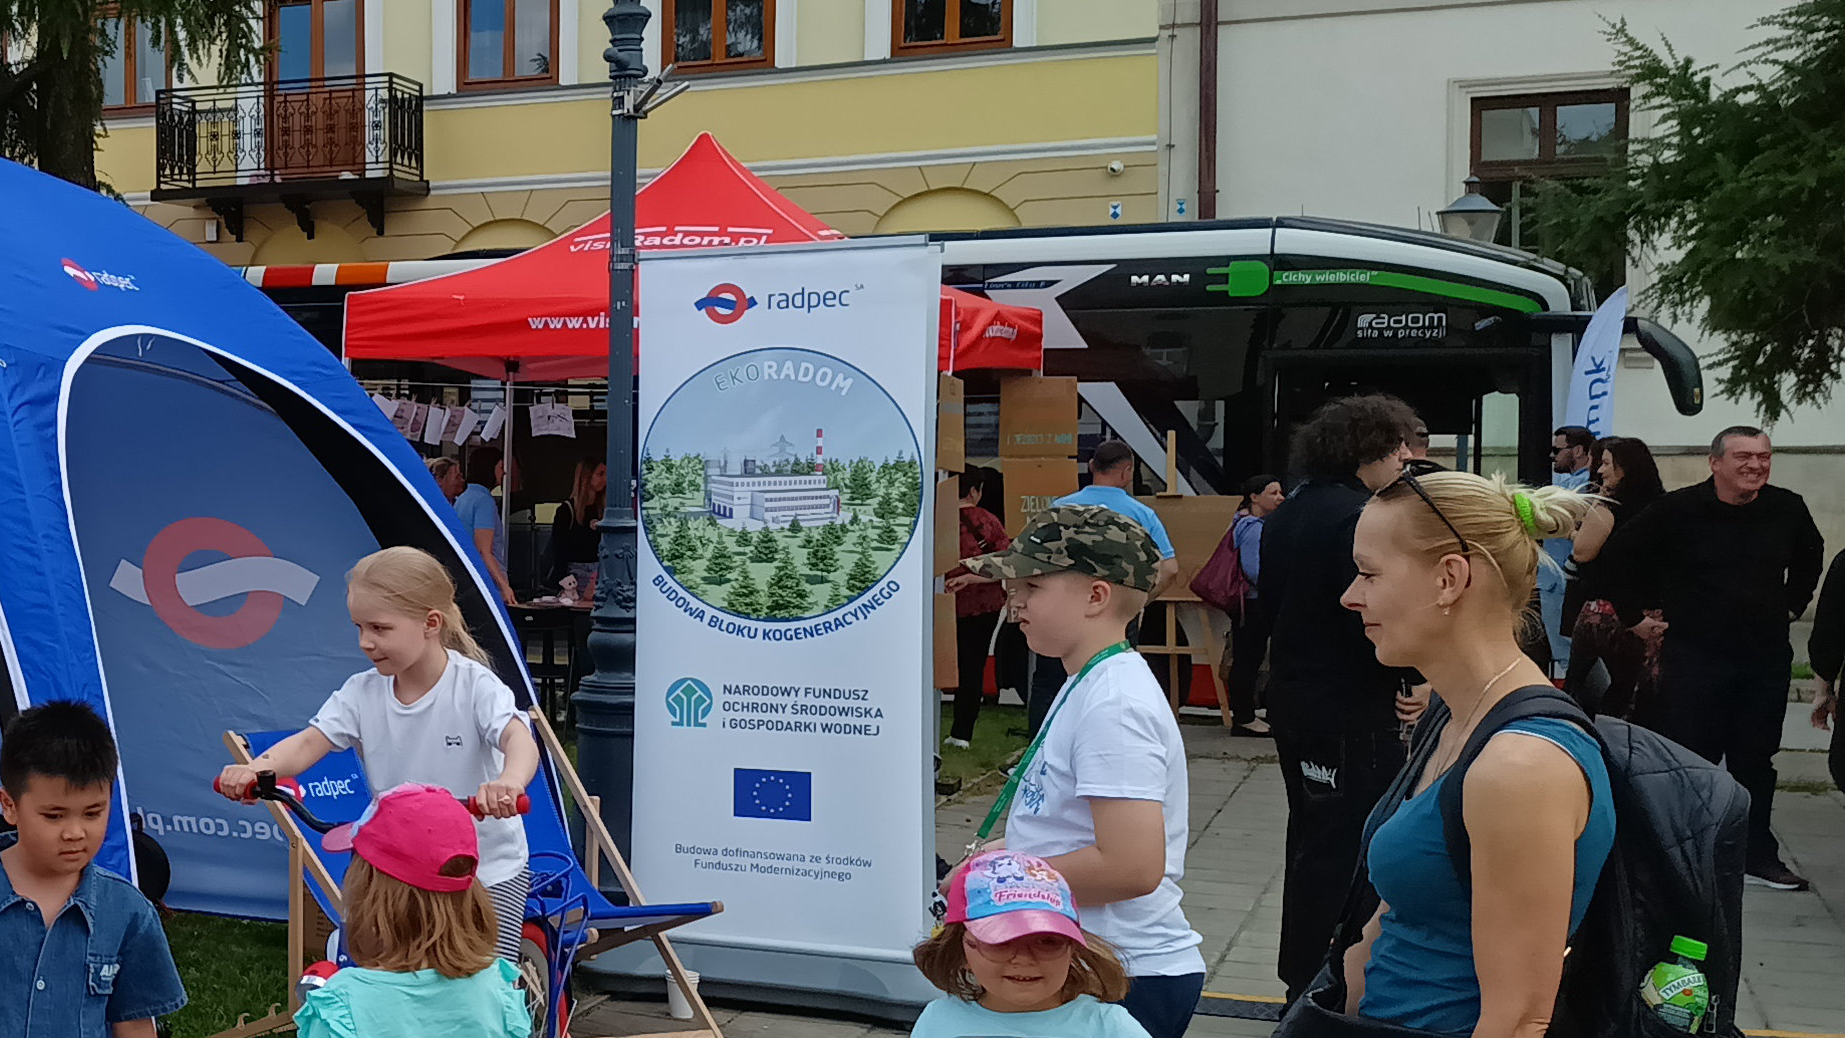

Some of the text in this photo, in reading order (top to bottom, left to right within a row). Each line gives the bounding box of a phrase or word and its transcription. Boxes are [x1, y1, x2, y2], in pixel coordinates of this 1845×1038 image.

[1130, 273, 1190, 287] MAN
[767, 286, 851, 314] radpec
[652, 574, 901, 642] BUDOWA BLOKU KOGENERACYJNEGO
[722, 684, 869, 701] NARODOWY FUNDUSZ
[722, 700, 884, 719] OCHRONY ŚRODOWISKA
[729, 718, 817, 733] GOSPODARKI
[820, 722, 880, 737] WODNEJ
[307, 775, 355, 800] radpec
[674, 843, 873, 869] Budowa dofinansowana ze środków
[693, 859, 852, 882] Funduszu Modernizacyjnego
[1661, 974, 1704, 997] TYMBARK
